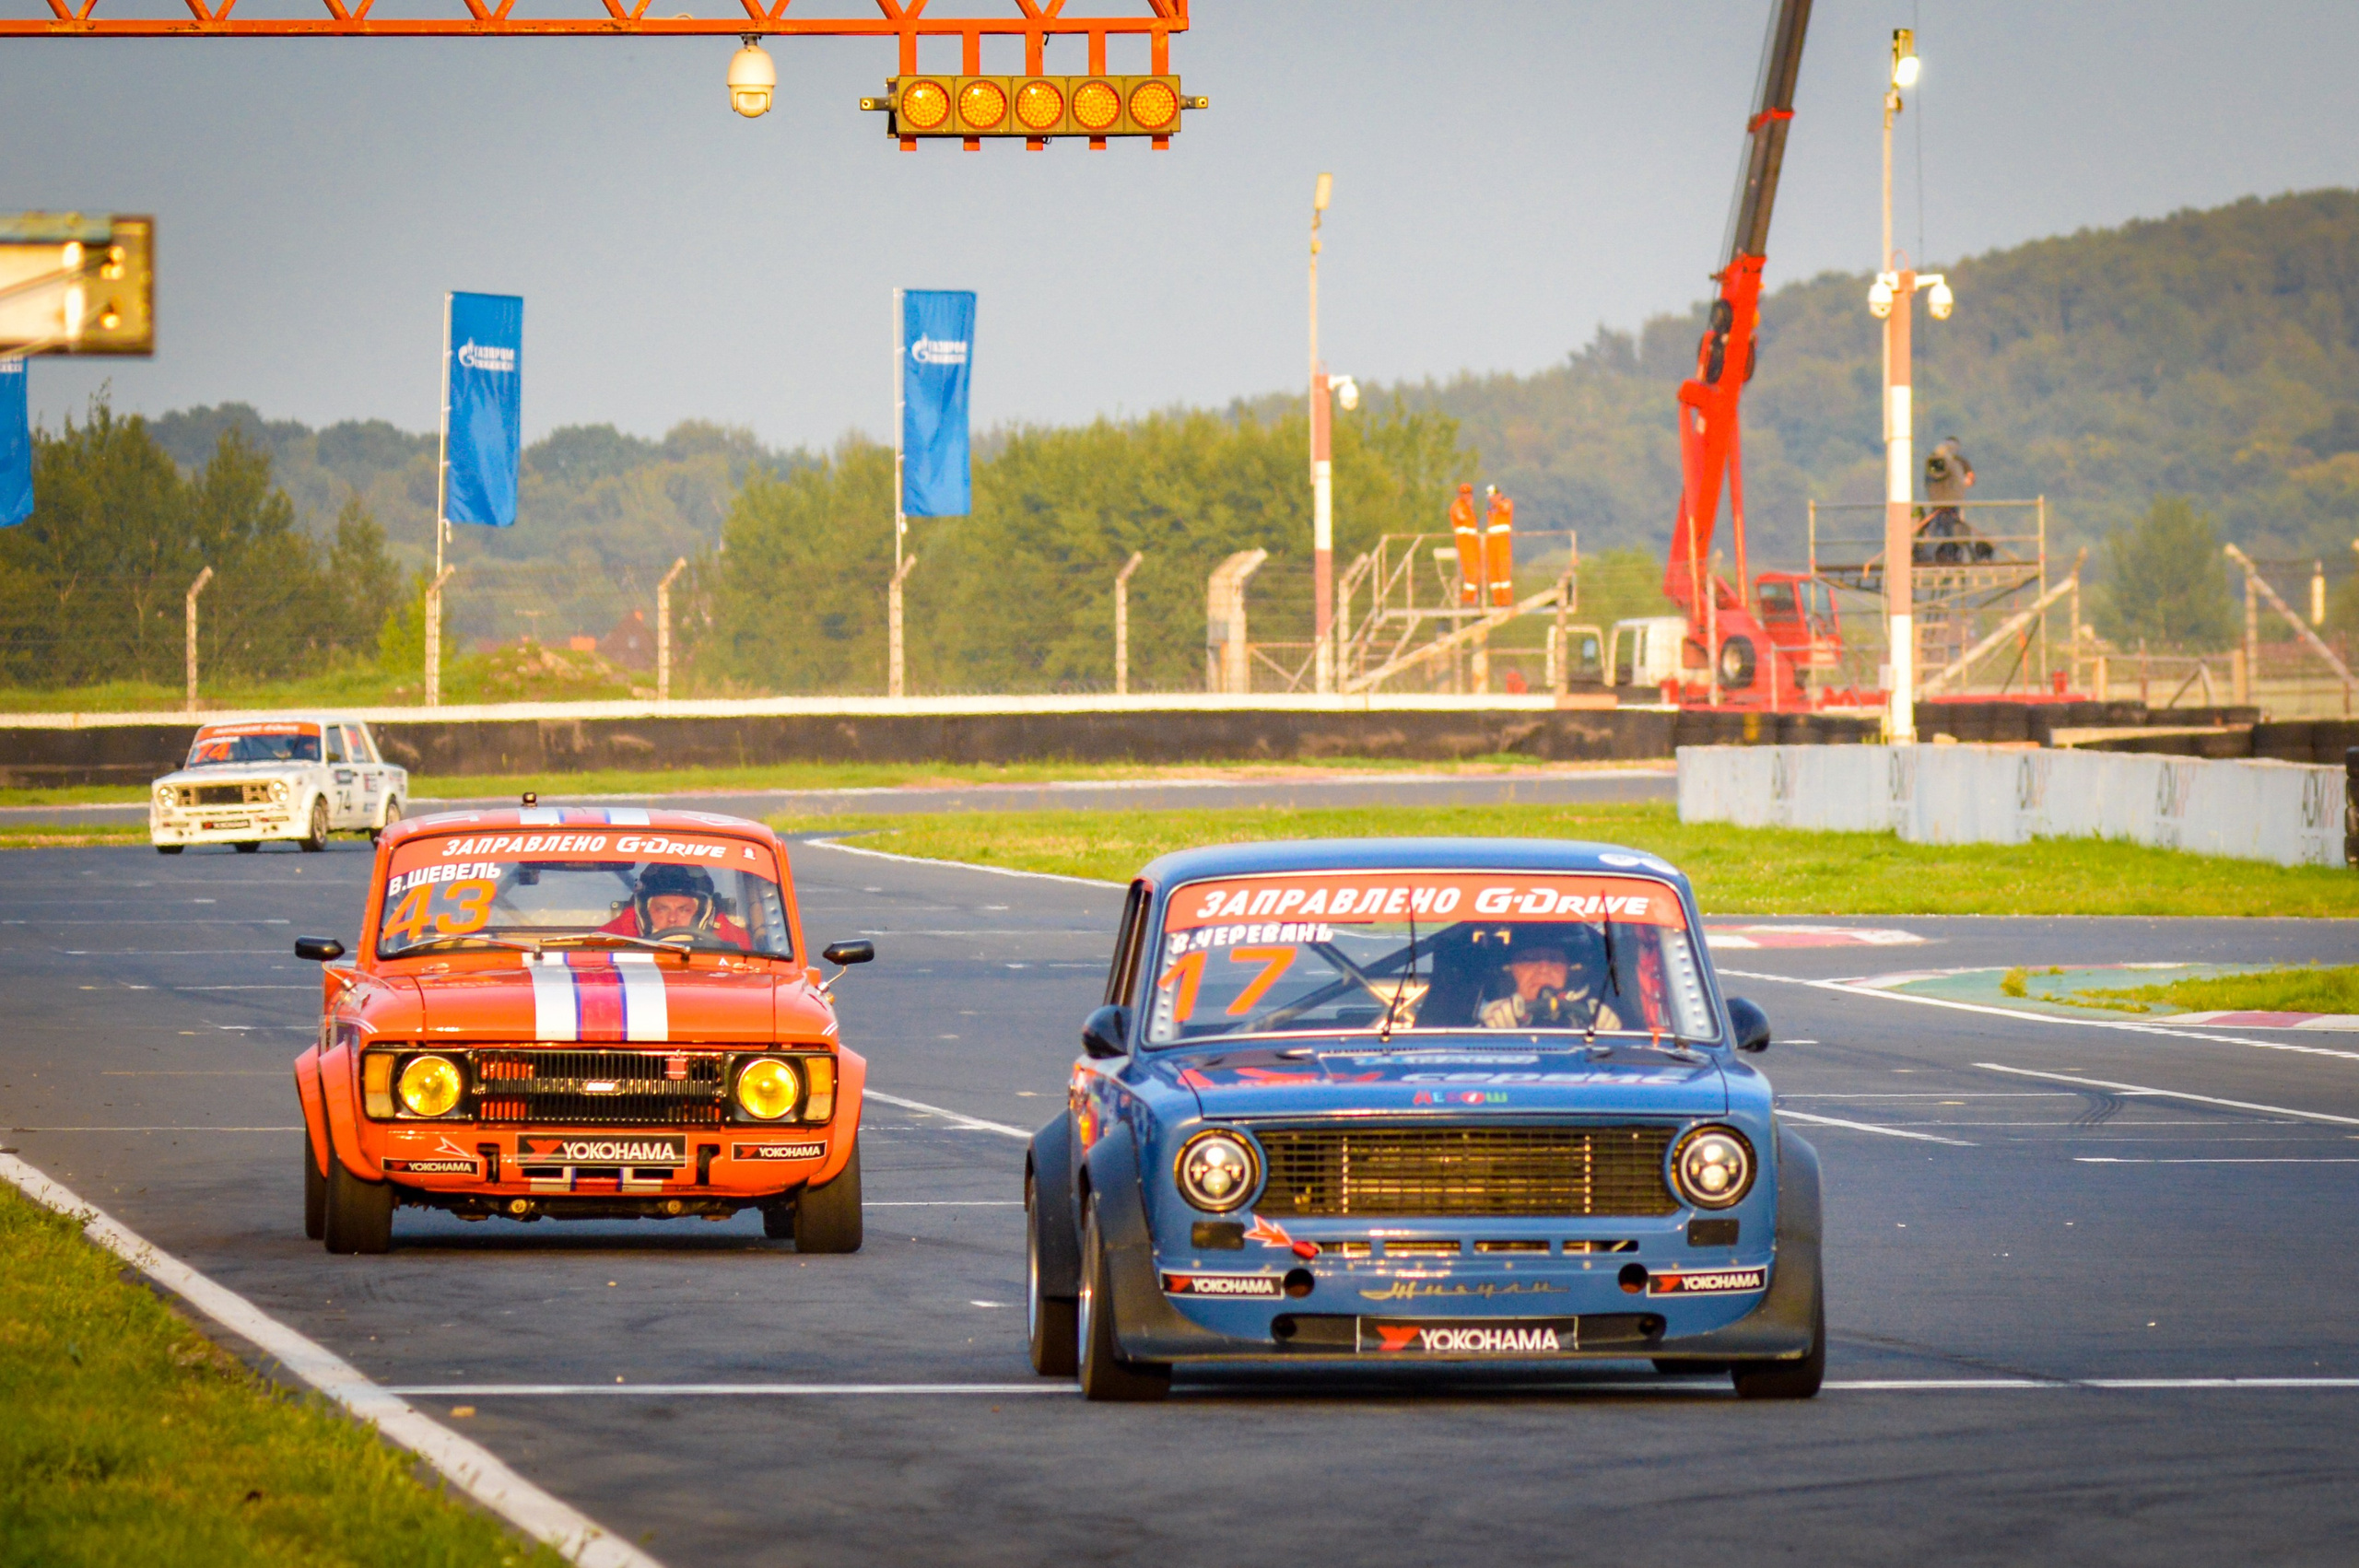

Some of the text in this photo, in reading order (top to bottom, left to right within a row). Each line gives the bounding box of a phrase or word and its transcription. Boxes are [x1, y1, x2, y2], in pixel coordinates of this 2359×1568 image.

[442, 835, 608, 857] ЗАПРАВЛЕНО
[388, 862, 502, 896] В.ШЕВЕЛЬ
[382, 878, 498, 941] 43
[1196, 887, 1461, 919] ЗАПРАВЛЕНО
[1171, 922, 1335, 954] В.ЧЕРЕВАНЬ
[1156, 946, 1297, 1023] 17
[562, 1141, 676, 1161] YOKOHAMA
[758, 1145, 821, 1158] YOKOHAMA
[408, 1162, 472, 1173] YOKOHAMA
[1192, 1277, 1274, 1293] YOKOHAMA
[1682, 1272, 1761, 1291] YOKOHAMA
[1419, 1328, 1560, 1351] YOKOHAMA
